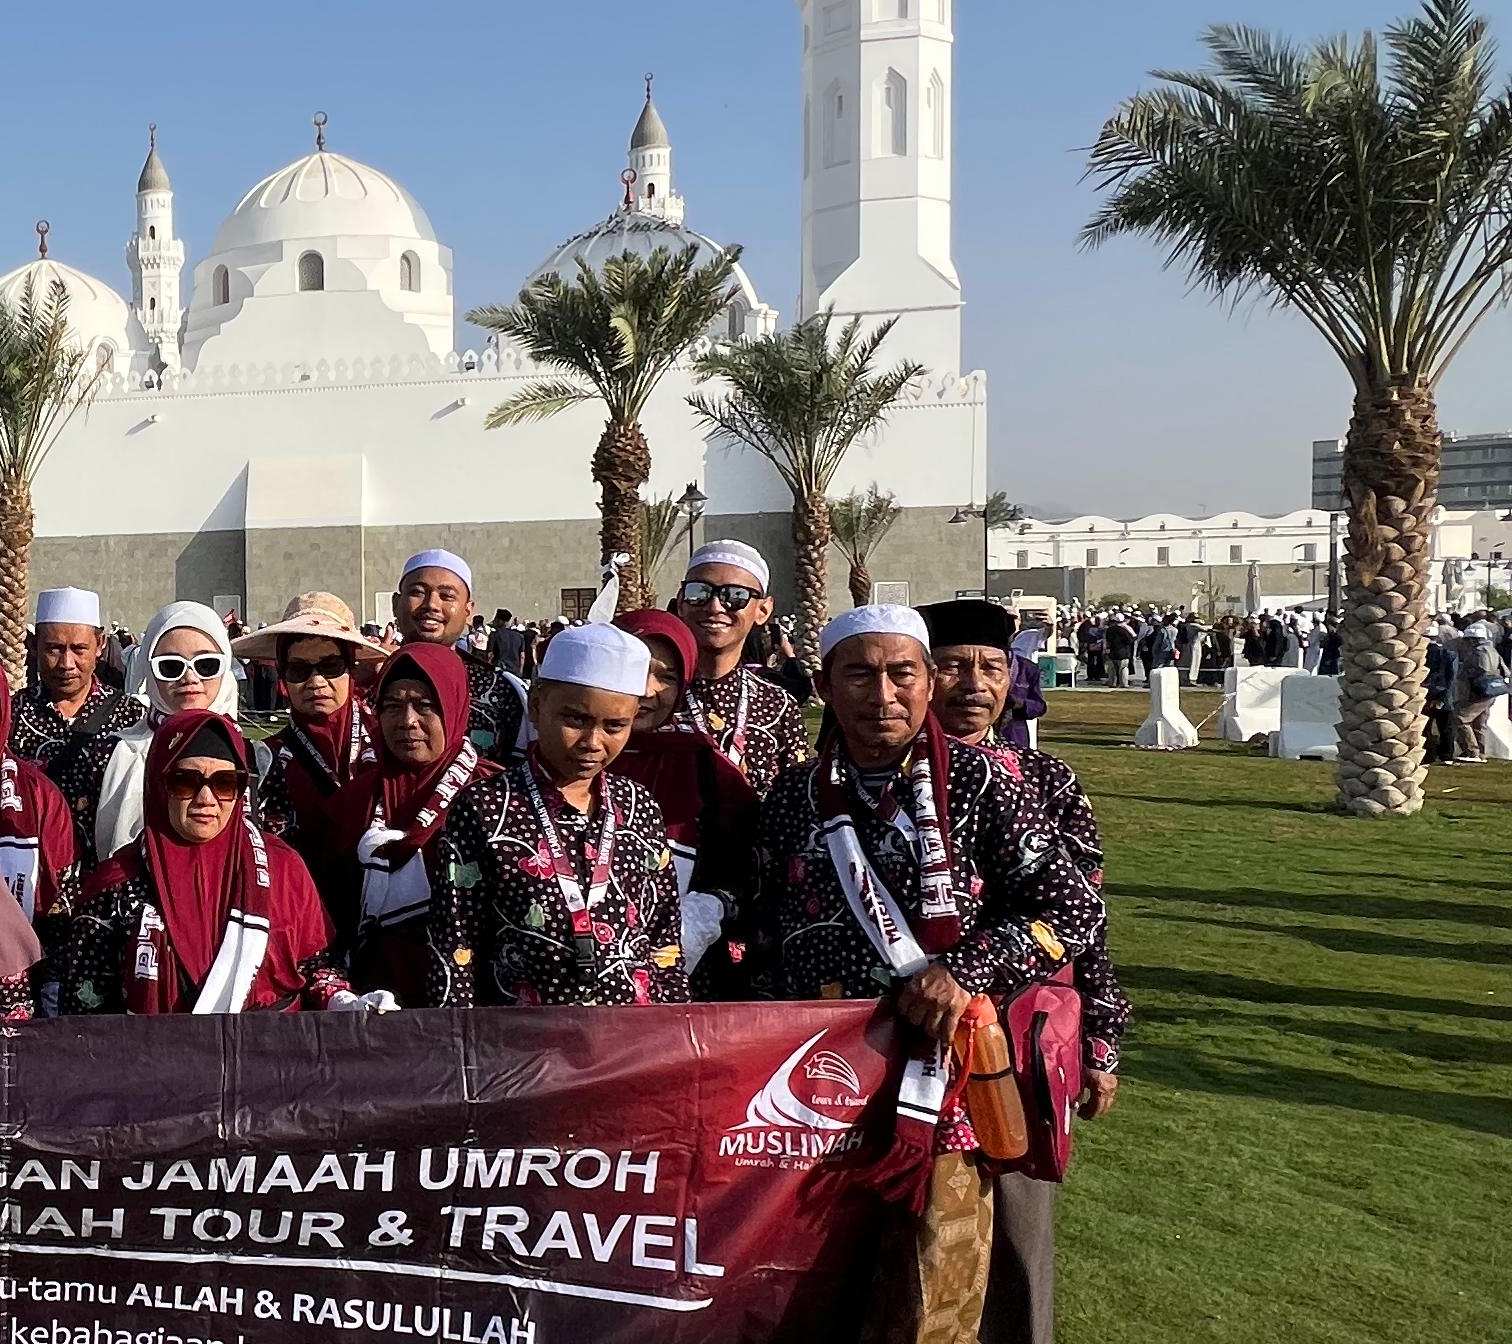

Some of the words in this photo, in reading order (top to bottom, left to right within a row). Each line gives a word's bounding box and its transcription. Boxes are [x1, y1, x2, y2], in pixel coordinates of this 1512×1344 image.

[718, 1130, 865, 1158] MUSLIMAH
[734, 1157, 775, 1168] Umrah
[122, 1150, 394, 1194] JAMAAH
[419, 1147, 661, 1194] UMROH
[149, 1207, 346, 1248] TOUR
[368, 1210, 415, 1247] &
[440, 1205, 726, 1278] TRAVEL
[126, 1281, 244, 1317] ALLAH
[253, 1289, 283, 1319] &
